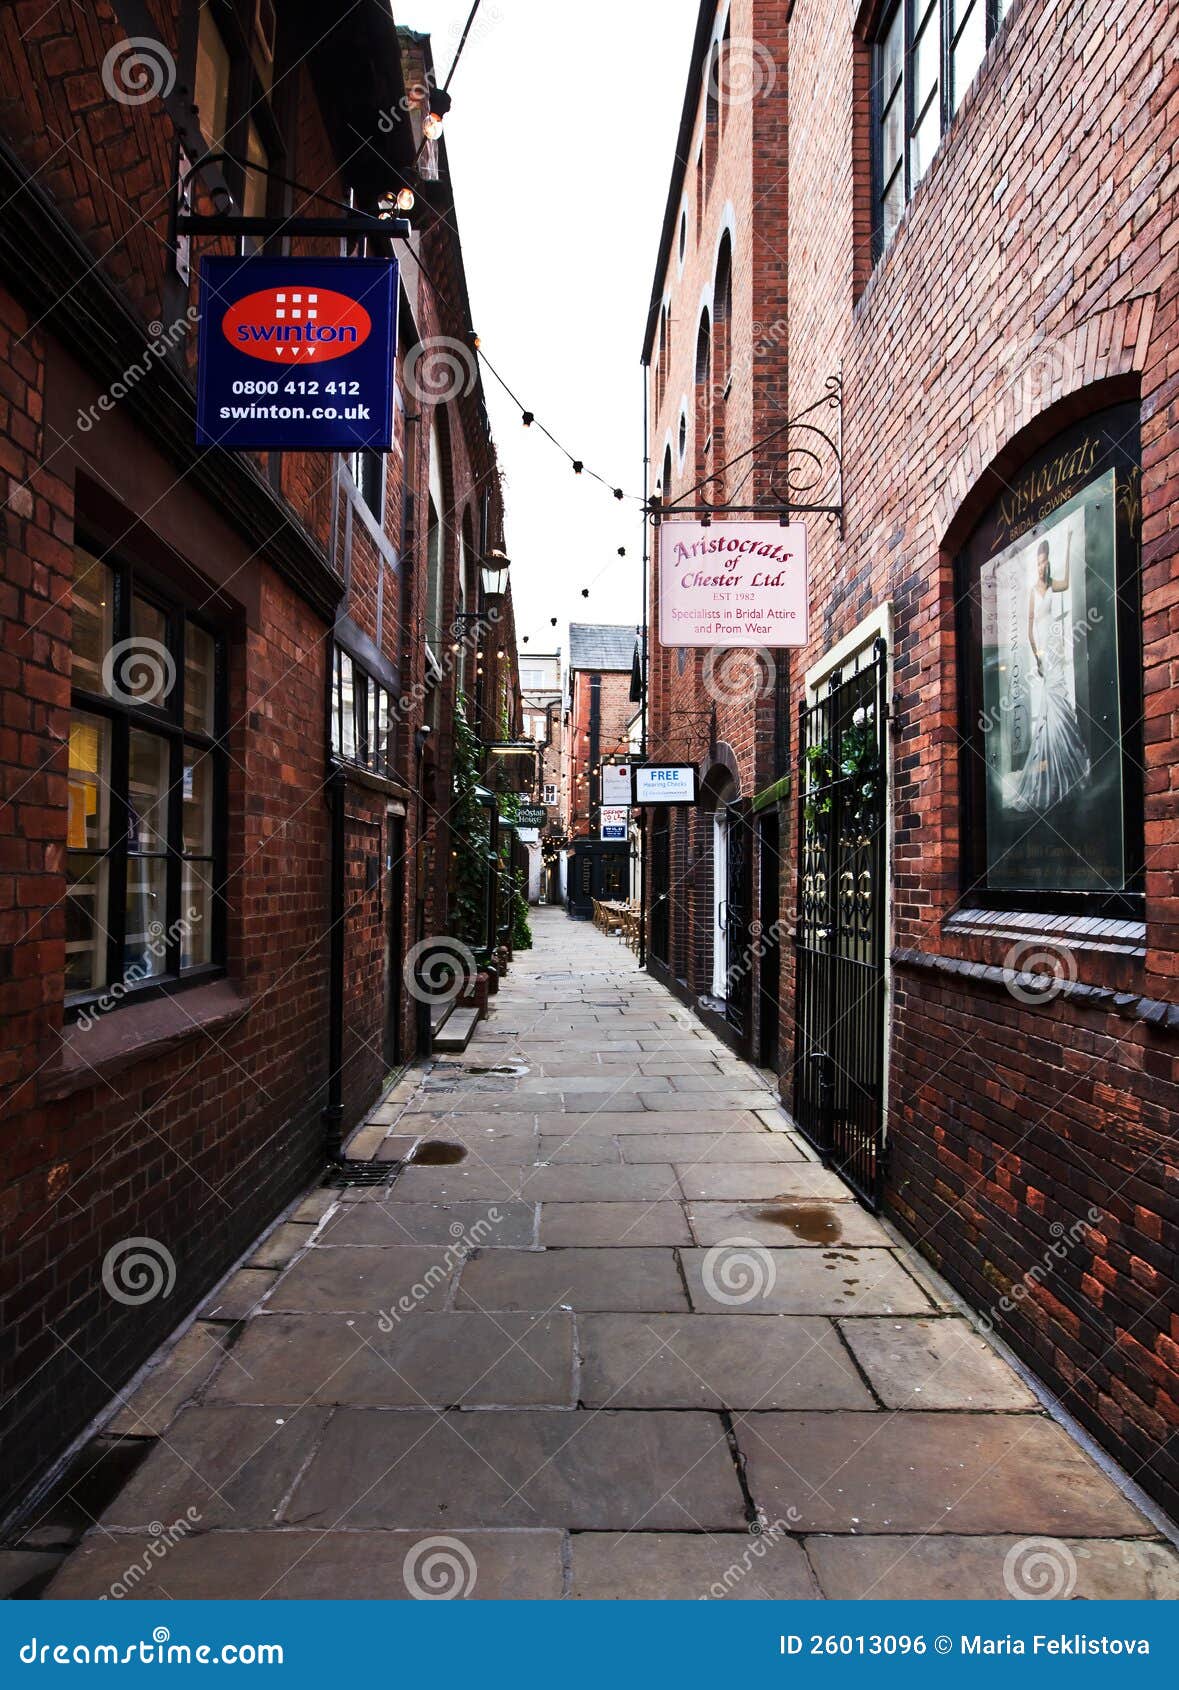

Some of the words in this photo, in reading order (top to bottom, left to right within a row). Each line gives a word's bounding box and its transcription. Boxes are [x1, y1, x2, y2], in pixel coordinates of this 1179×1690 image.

[236, 321, 357, 342] swinton
[232, 381, 278, 395] 0800
[284, 381, 319, 395] 412
[325, 381, 360, 396] 412
[219, 404, 370, 420] swinton.co.uk
[990, 437, 1099, 552] Aristocrats
[1010, 516, 1036, 541] BRIDAL
[1038, 485, 1073, 519] GOWNS
[674, 536, 793, 567] Aristocrats
[725, 555, 742, 572] of
[681, 571, 743, 588] Chester
[750, 571, 786, 587] Ltd.
[713, 592, 731, 601] EST
[735, 592, 756, 601] 1982
[671, 609, 721, 620] Specialists
[724, 609, 732, 619] in
[736, 609, 763, 619] Bridal
[767, 609, 797, 619] Attire
[694, 624, 712, 633] and
[715, 624, 742, 633] Prom
[745, 624, 772, 633] Wear
[650, 770, 679, 781] FREE
